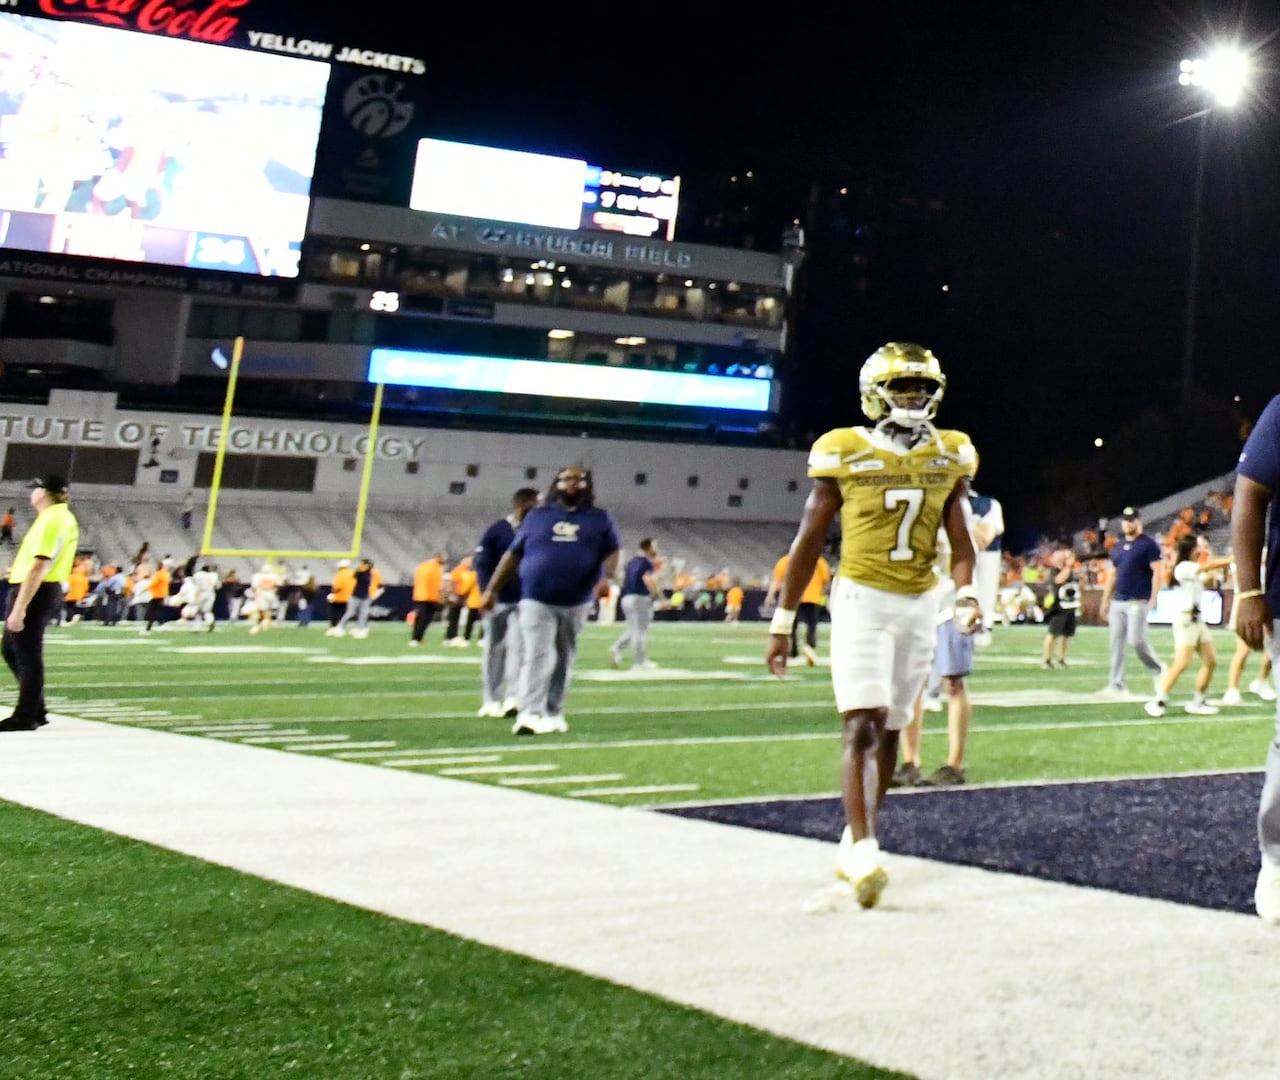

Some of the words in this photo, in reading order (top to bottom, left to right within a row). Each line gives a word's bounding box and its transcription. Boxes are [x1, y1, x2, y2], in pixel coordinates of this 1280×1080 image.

[248, 30, 334, 58] YELLOW
[335, 47, 427, 75] JACKETS
[625, 243, 692, 268] FIELD
[183, 424, 426, 459] TECHNOLOGY
[883, 487, 928, 563] 7
